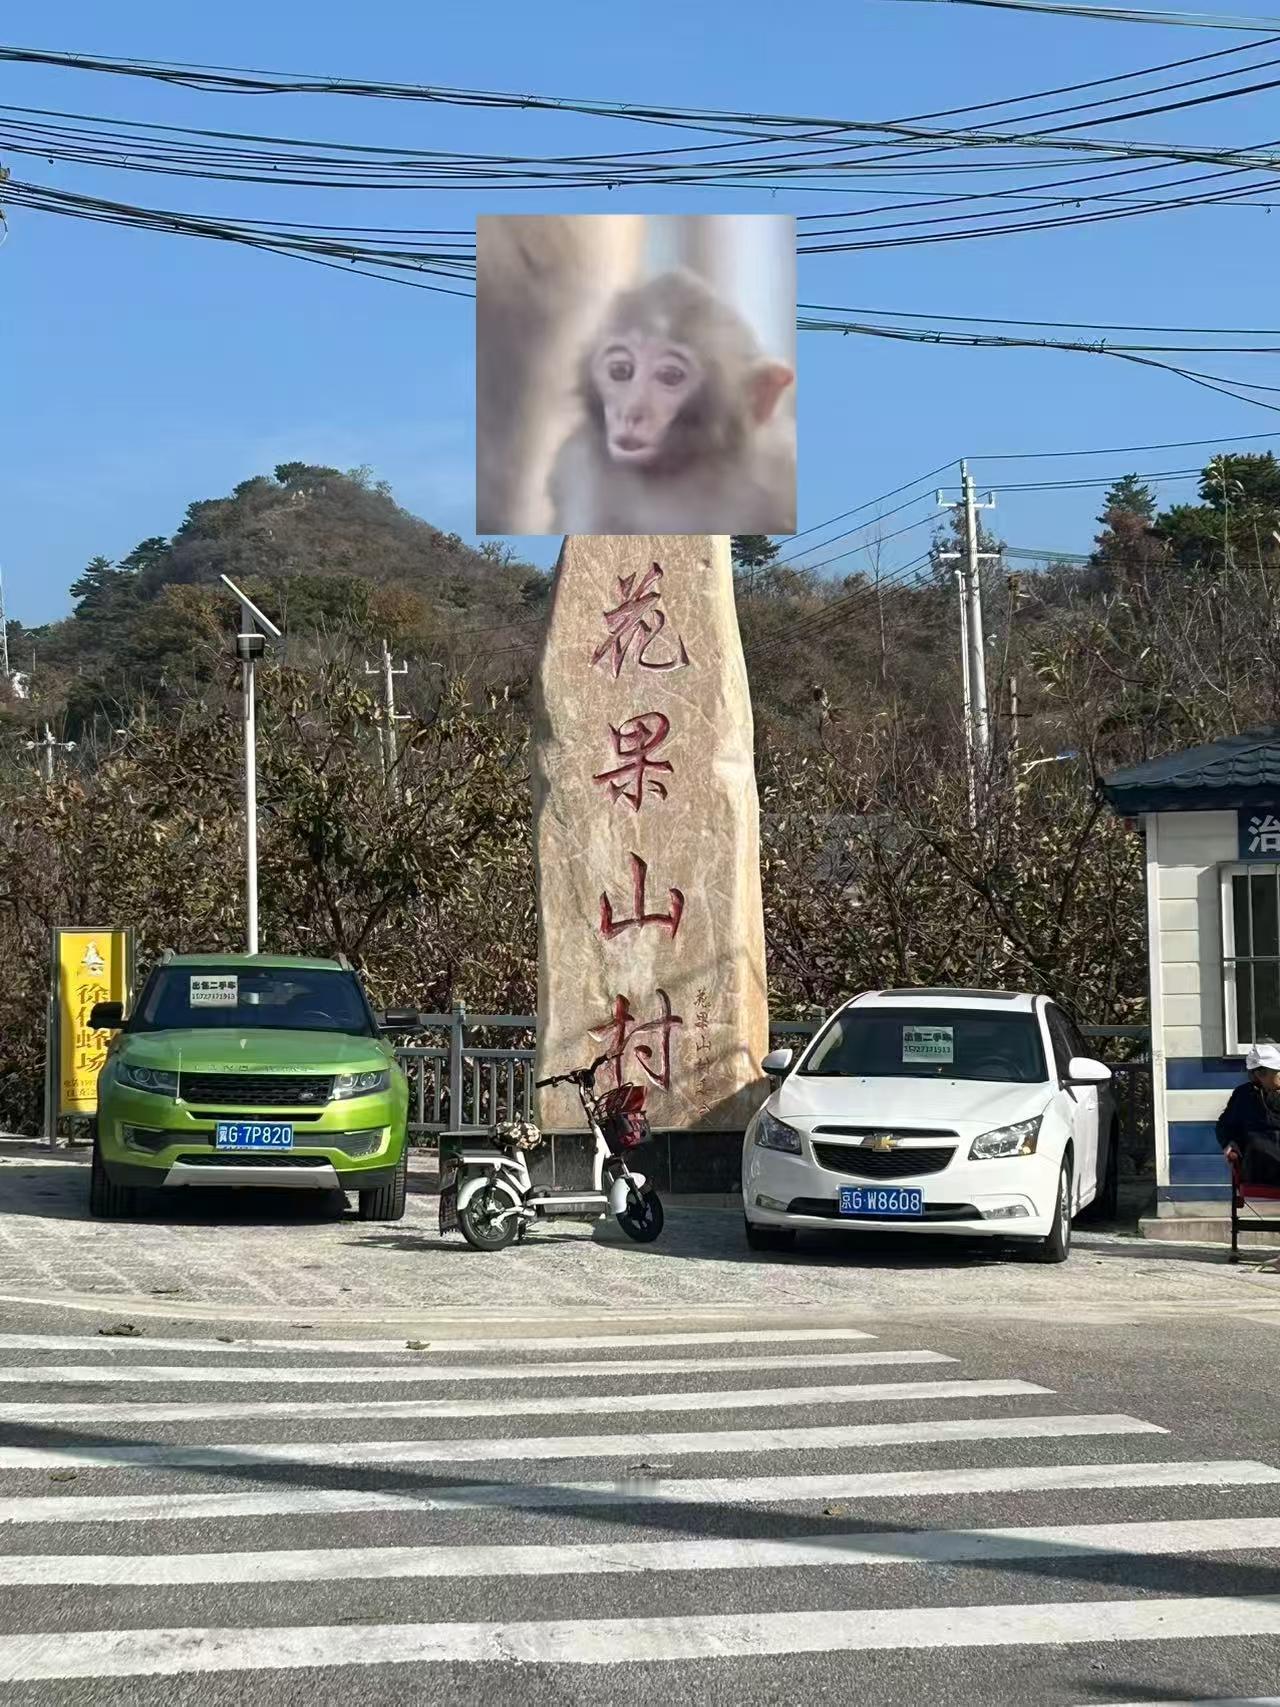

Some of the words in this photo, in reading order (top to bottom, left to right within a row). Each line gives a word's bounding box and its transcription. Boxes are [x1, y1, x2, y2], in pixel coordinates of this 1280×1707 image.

[588, 561, 690, 1091] 花果山村
[1248, 815, 1280, 853] 治
